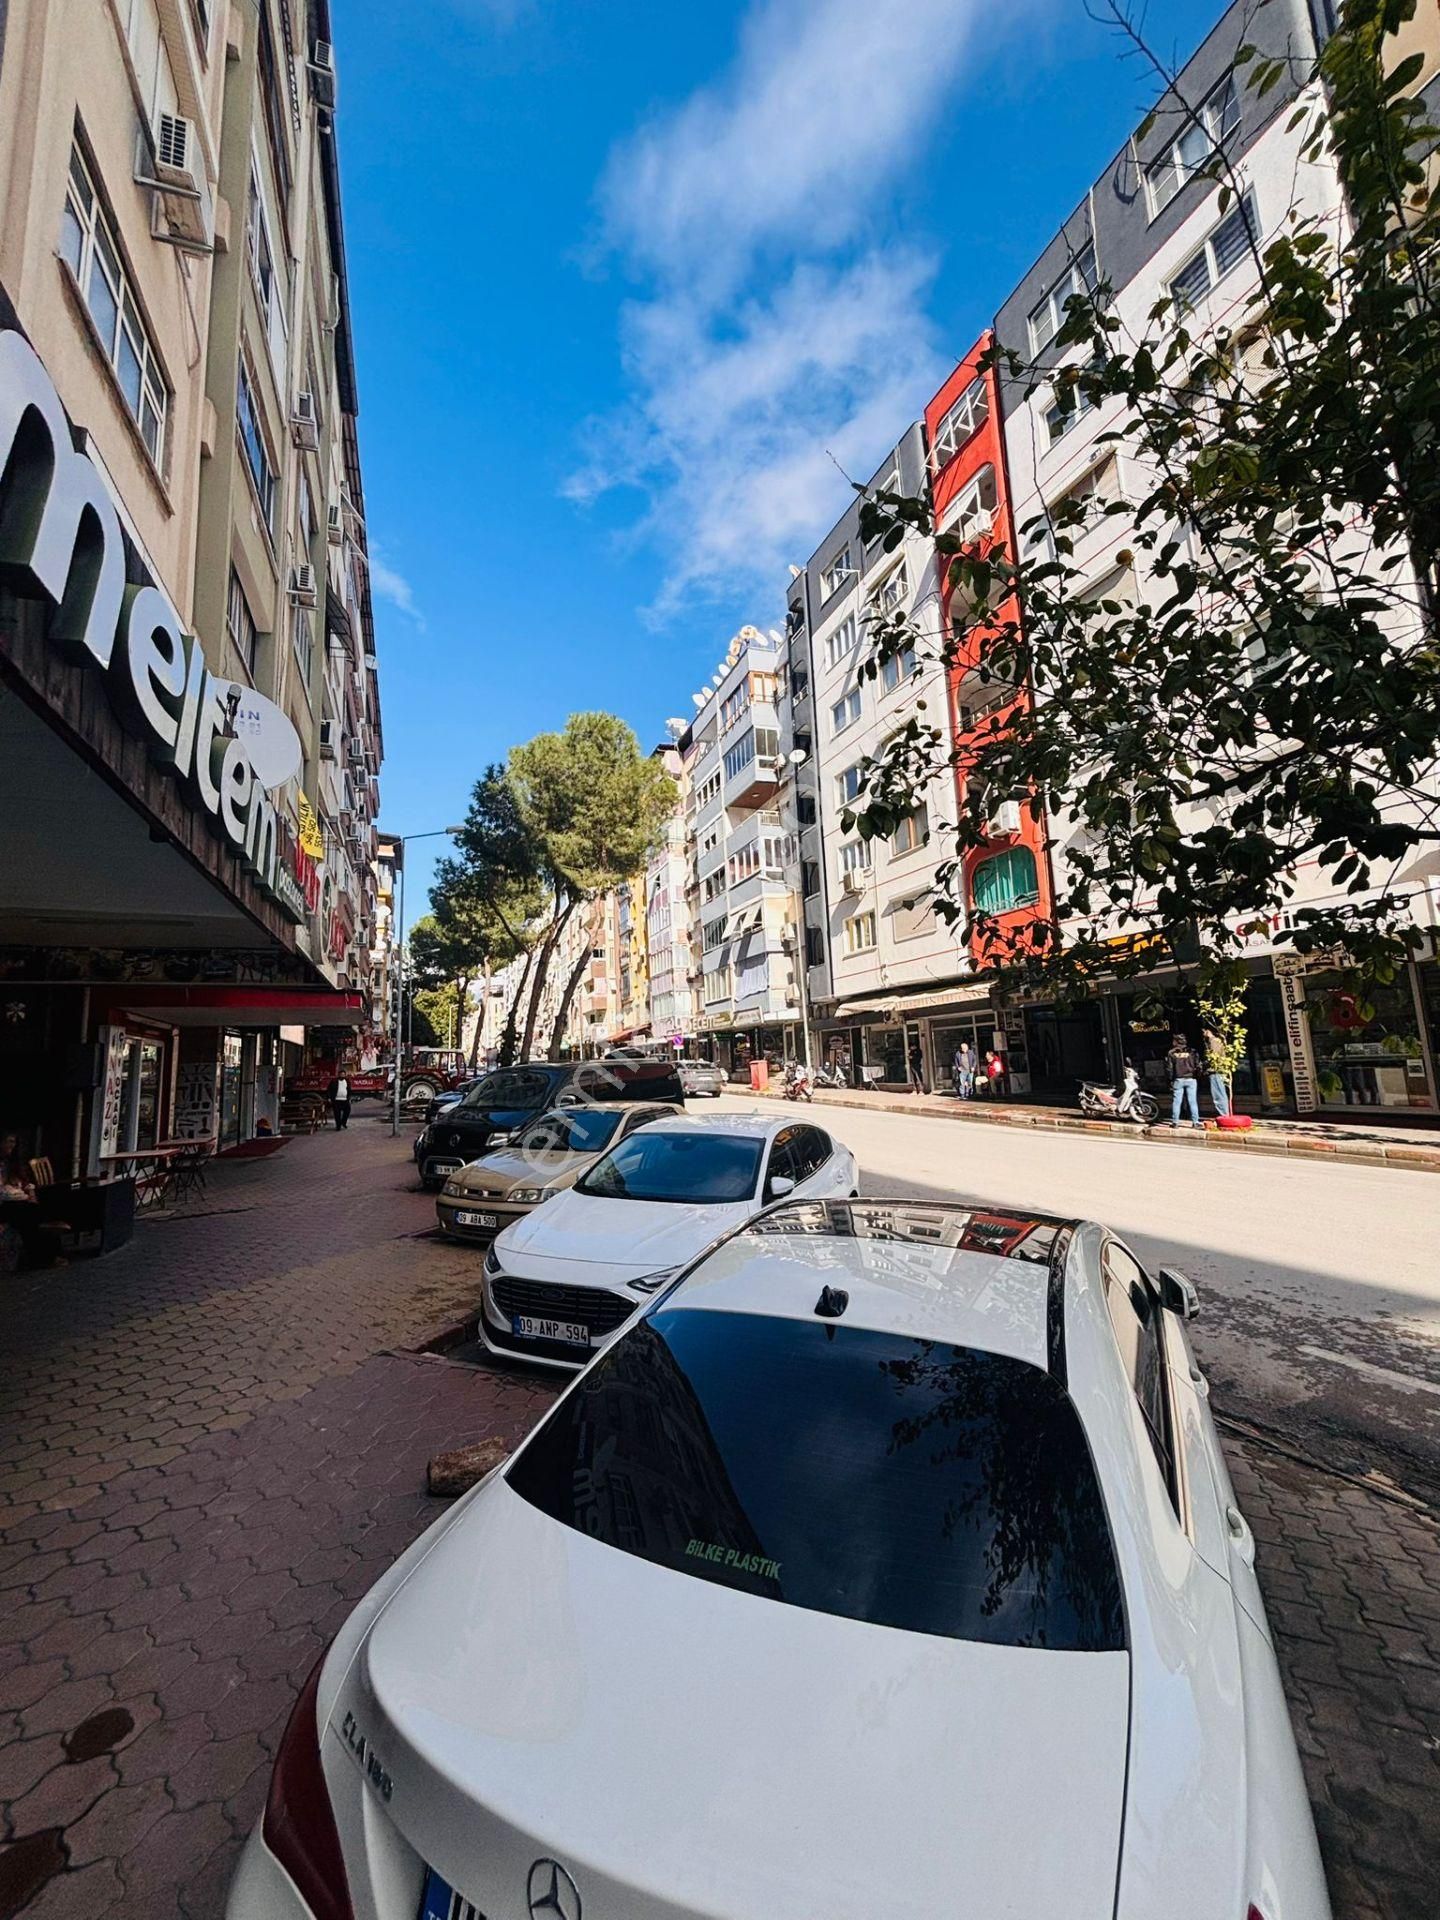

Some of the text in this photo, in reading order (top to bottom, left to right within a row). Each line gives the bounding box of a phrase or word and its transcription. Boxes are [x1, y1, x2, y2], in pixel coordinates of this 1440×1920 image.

[0, 329, 277, 892] meltem
[519, 1318, 587, 1342] 09 ANP 594
[341, 1709, 368, 1767] CLA
